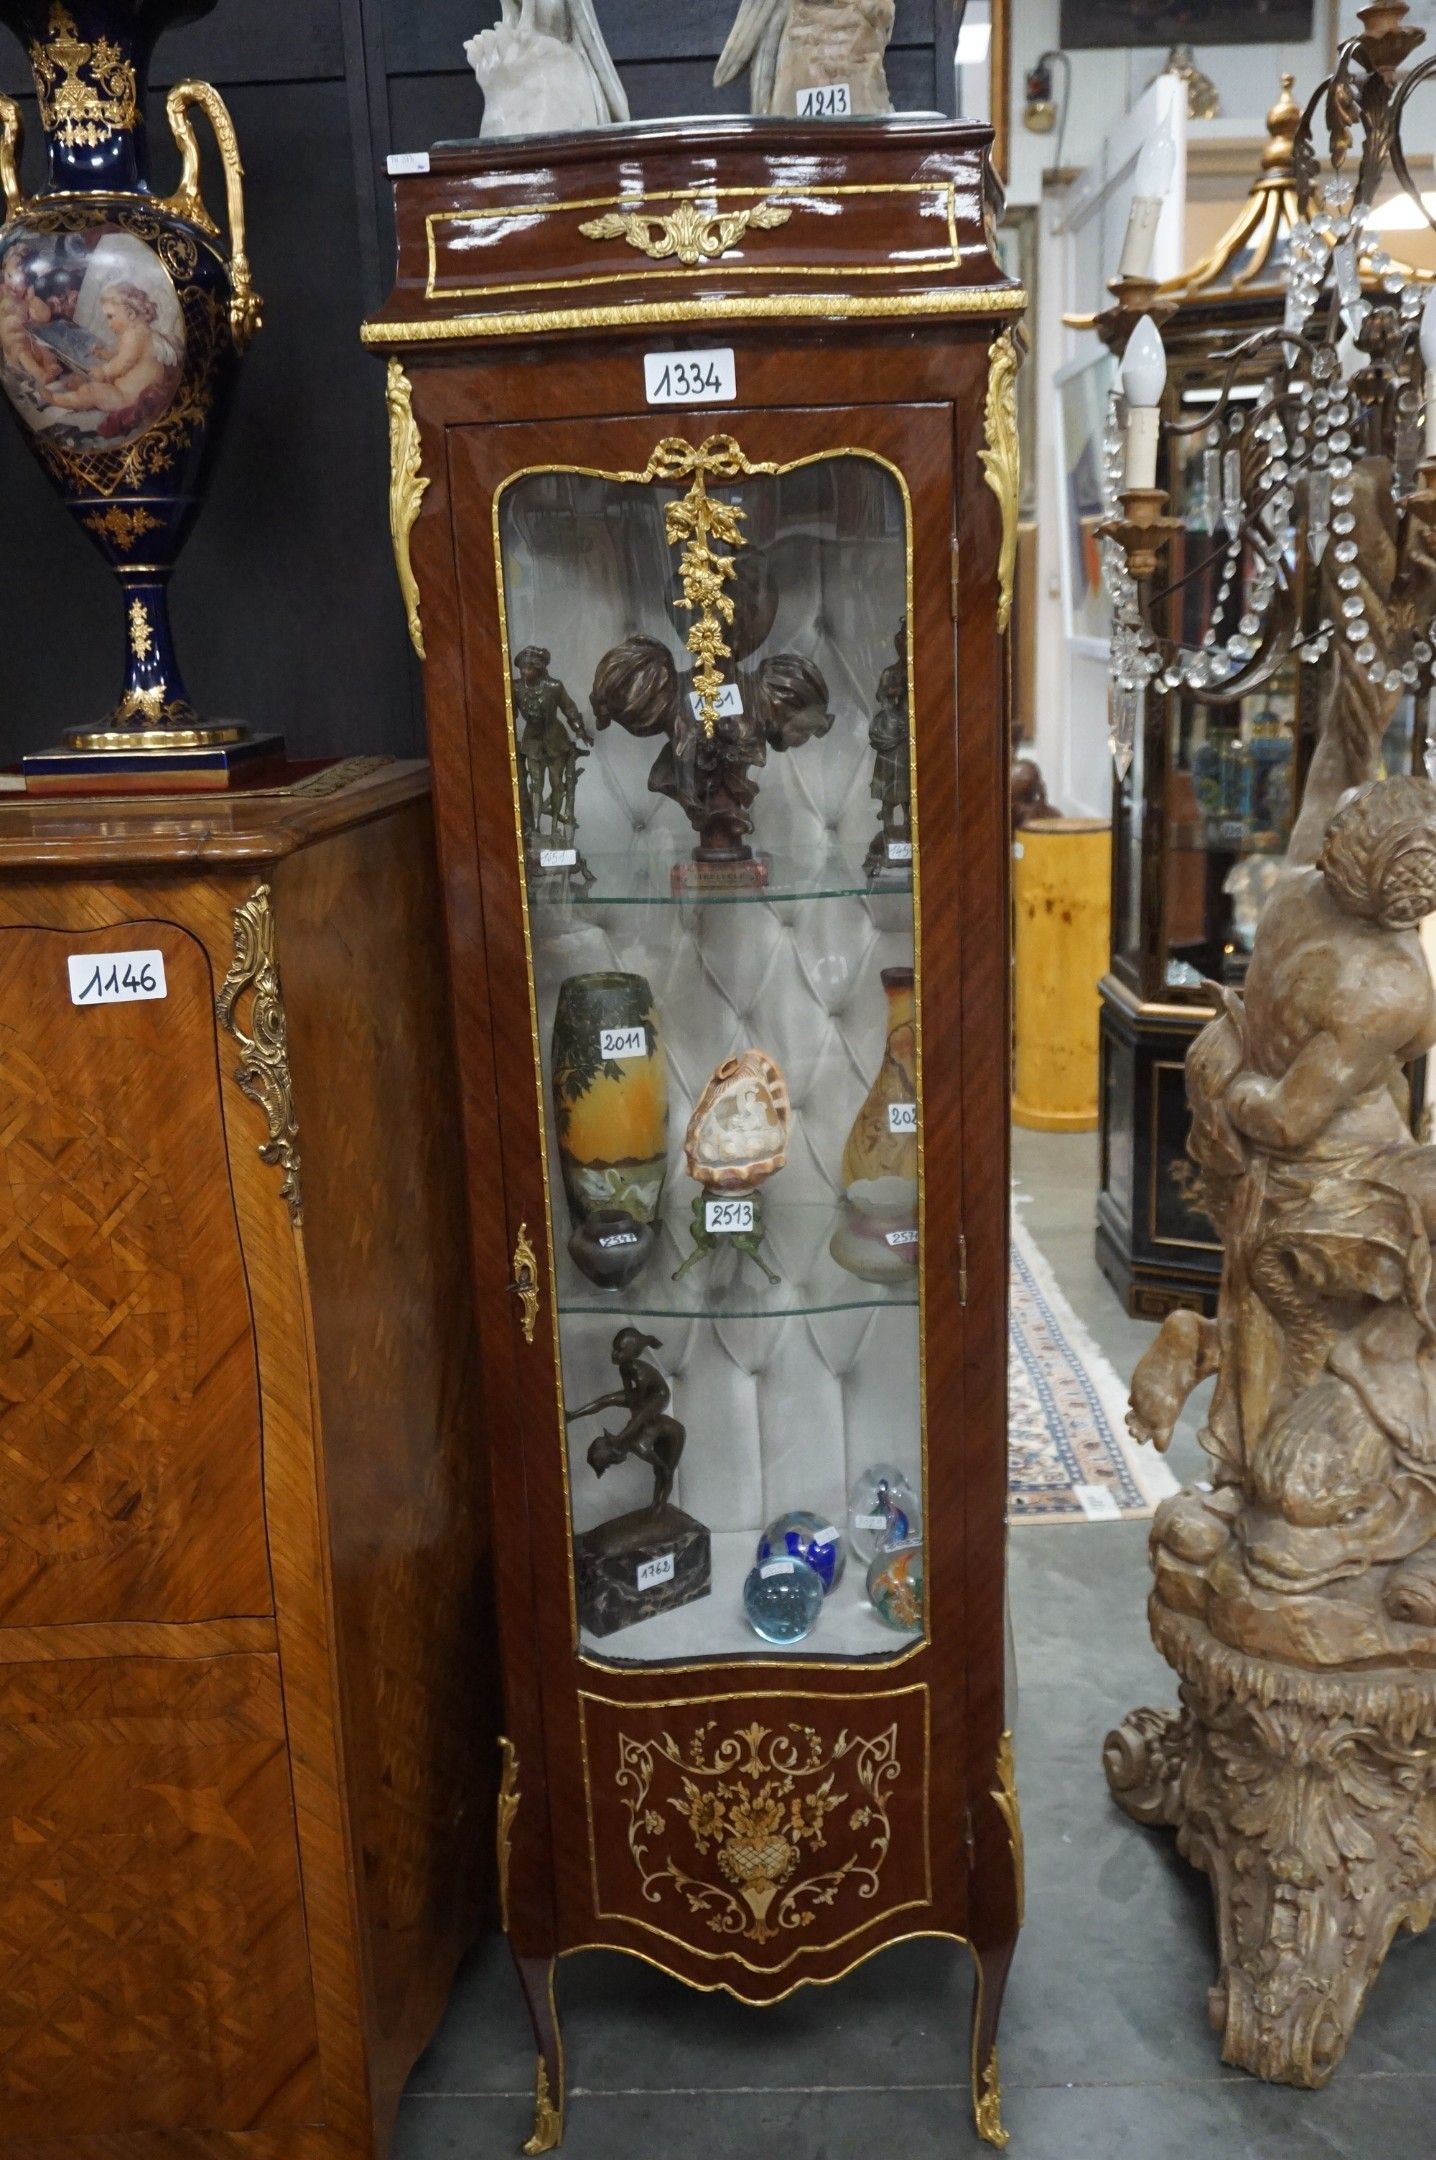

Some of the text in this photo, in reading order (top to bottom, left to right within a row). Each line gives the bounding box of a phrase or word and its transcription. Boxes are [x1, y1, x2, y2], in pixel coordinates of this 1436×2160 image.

[802, 88, 847, 116] 1213
[653, 362, 722, 397] 1334
[78, 963, 157, 1000] 1146
[603, 1032, 640, 1051] 2011
[711, 1203, 752, 1227] 2513
